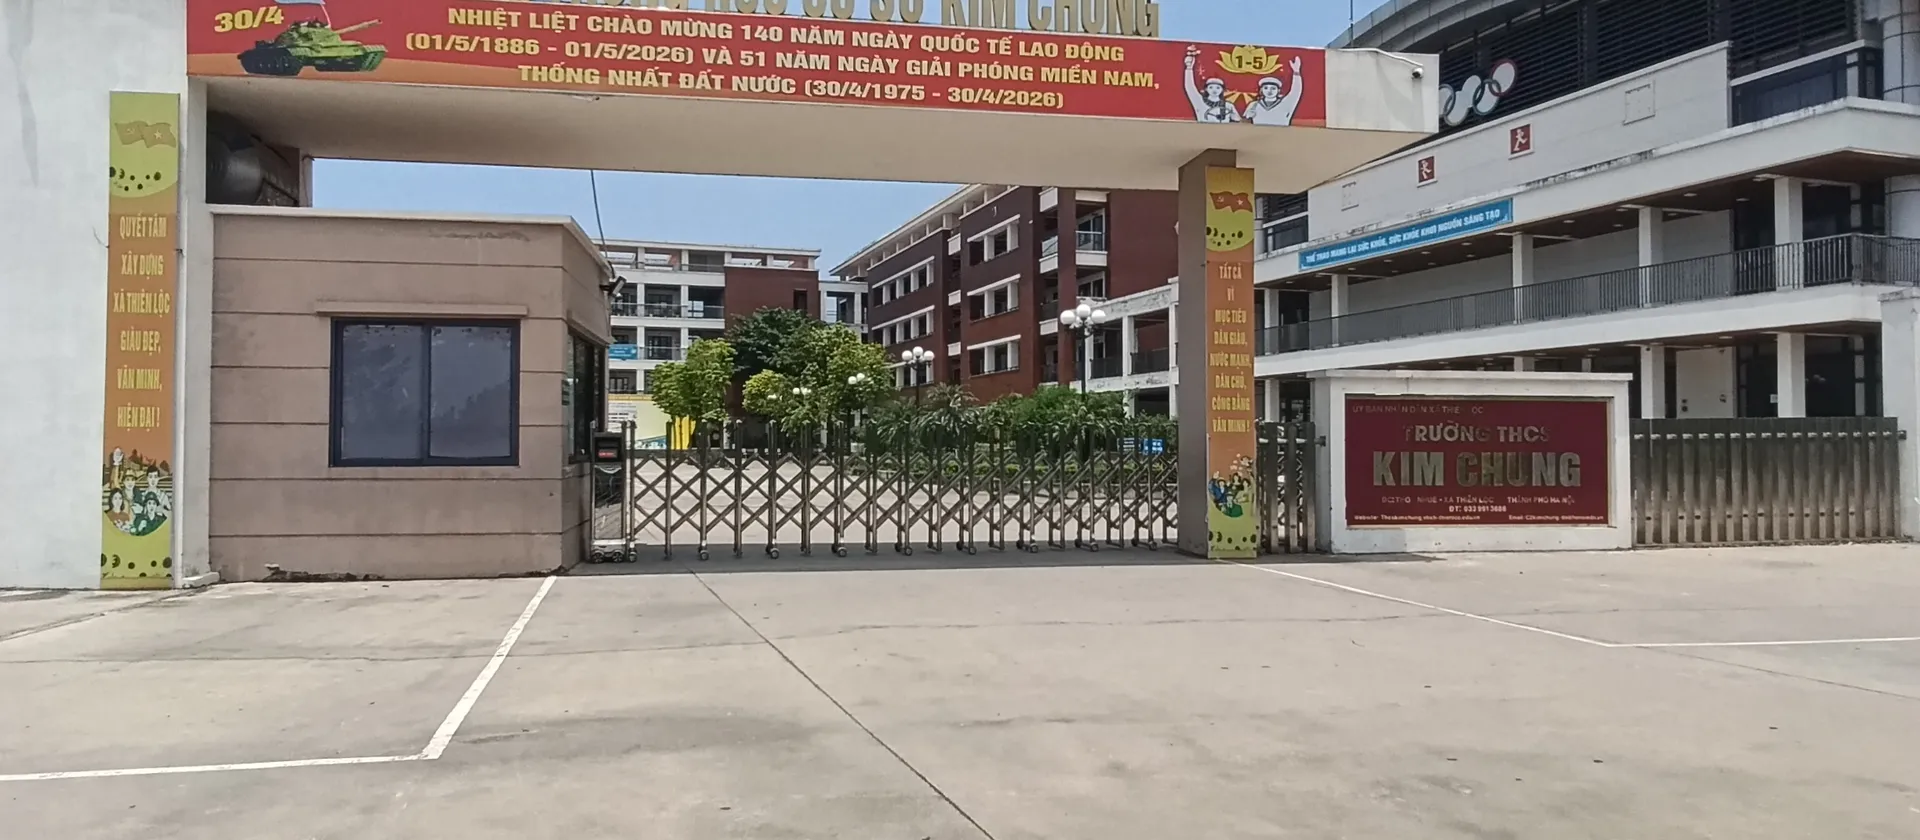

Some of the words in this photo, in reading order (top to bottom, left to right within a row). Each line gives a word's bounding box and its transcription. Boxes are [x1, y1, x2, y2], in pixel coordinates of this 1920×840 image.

[214, 6, 284, 32] 30/4
[448, 7, 522, 30] NHIỆT
[530, 10, 579, 33] LIỆT
[587, 15, 652, 34] CHÀO
[661, 18, 733, 39] MỪNG
[741, 25, 783, 42] 140
[791, 26, 844, 45] NĂM
[852, 31, 913, 49] NGÀY
[921, 32, 980, 53] QUỐC
[987, 36, 1013, 55] TẾ
[1019, 41, 1058, 57] LAO
[1065, 41, 1124, 63] ĐỘNG
[406, 32, 540, 55] (01/5/1886
[565, 41, 694, 64] 01/5/2026)
[702, 46, 733, 65] VÀ
[740, 51, 765, 67] 51
[776, 50, 830, 70] NĂM
[838, 55, 899, 74] NGÀY
[907, 56, 951, 77] GIẢI
[958, 61, 1034, 81] PHÓNG
[1041, 64, 1097, 84] MIỀN
[1104, 71, 1159, 89] NAM,
[1235, 55, 1263, 70] 1-5
[518, 62, 600, 84] THỐNG
[608, 66, 672, 88] NHẤT
[679, 69, 724, 90] ĐẤT
[732, 75, 796, 94] NƯỚC
[805, 80, 925, 101] (30/4/1975
[948, 87, 1063, 109] 30/4/2026)
[120, 213, 146, 239] QUYẾT
[148, 213, 167, 237] TÂM
[1463, 212, 1484, 226] SÁNG
[1485, 209, 1500, 221] TẠO
[121, 250, 138, 275] XÂY
[139, 253, 164, 280] DỰNG
[1219, 261, 1232, 279] TẤT
[1232, 262, 1242, 280] CẢ
[113, 288, 125, 312] XÃ
[126, 288, 152, 313] THIÊN
[153, 288, 170, 318] LỘC
[120, 326, 141, 351] GIÀU
[142, 330, 161, 356] ĐẸP,
[117, 364, 135, 390] VĂN
[136, 368, 162, 392] MINH,
[117, 402, 138, 432] HIỆN
[1497, 425, 1549, 442] THCS
[1373, 452, 1444, 486] KIM
[1456, 451, 1581, 487] CHUNG
